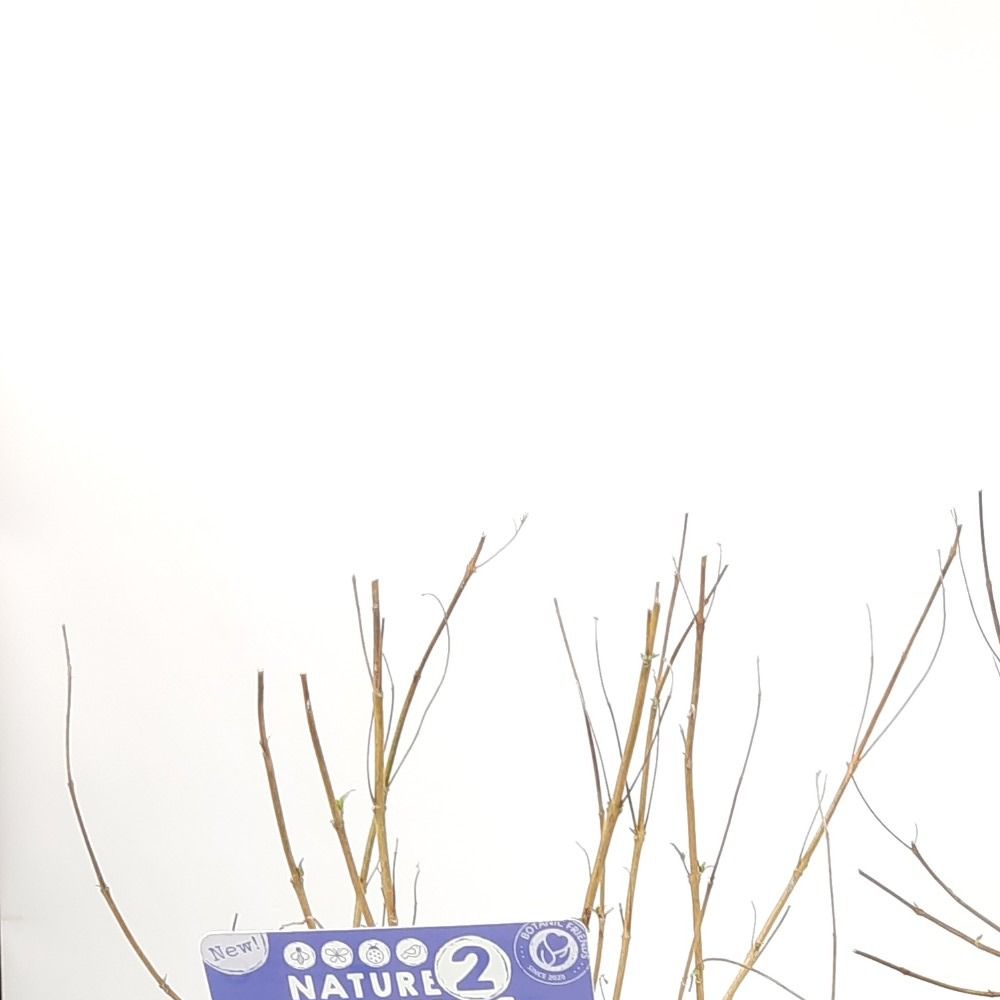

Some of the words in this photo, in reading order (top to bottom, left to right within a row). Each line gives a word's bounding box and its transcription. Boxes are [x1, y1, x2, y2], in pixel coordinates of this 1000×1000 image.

[207, 936, 260, 963] New!
[287, 970, 442, 1000] NATURE
[450, 944, 495, 991] 2
